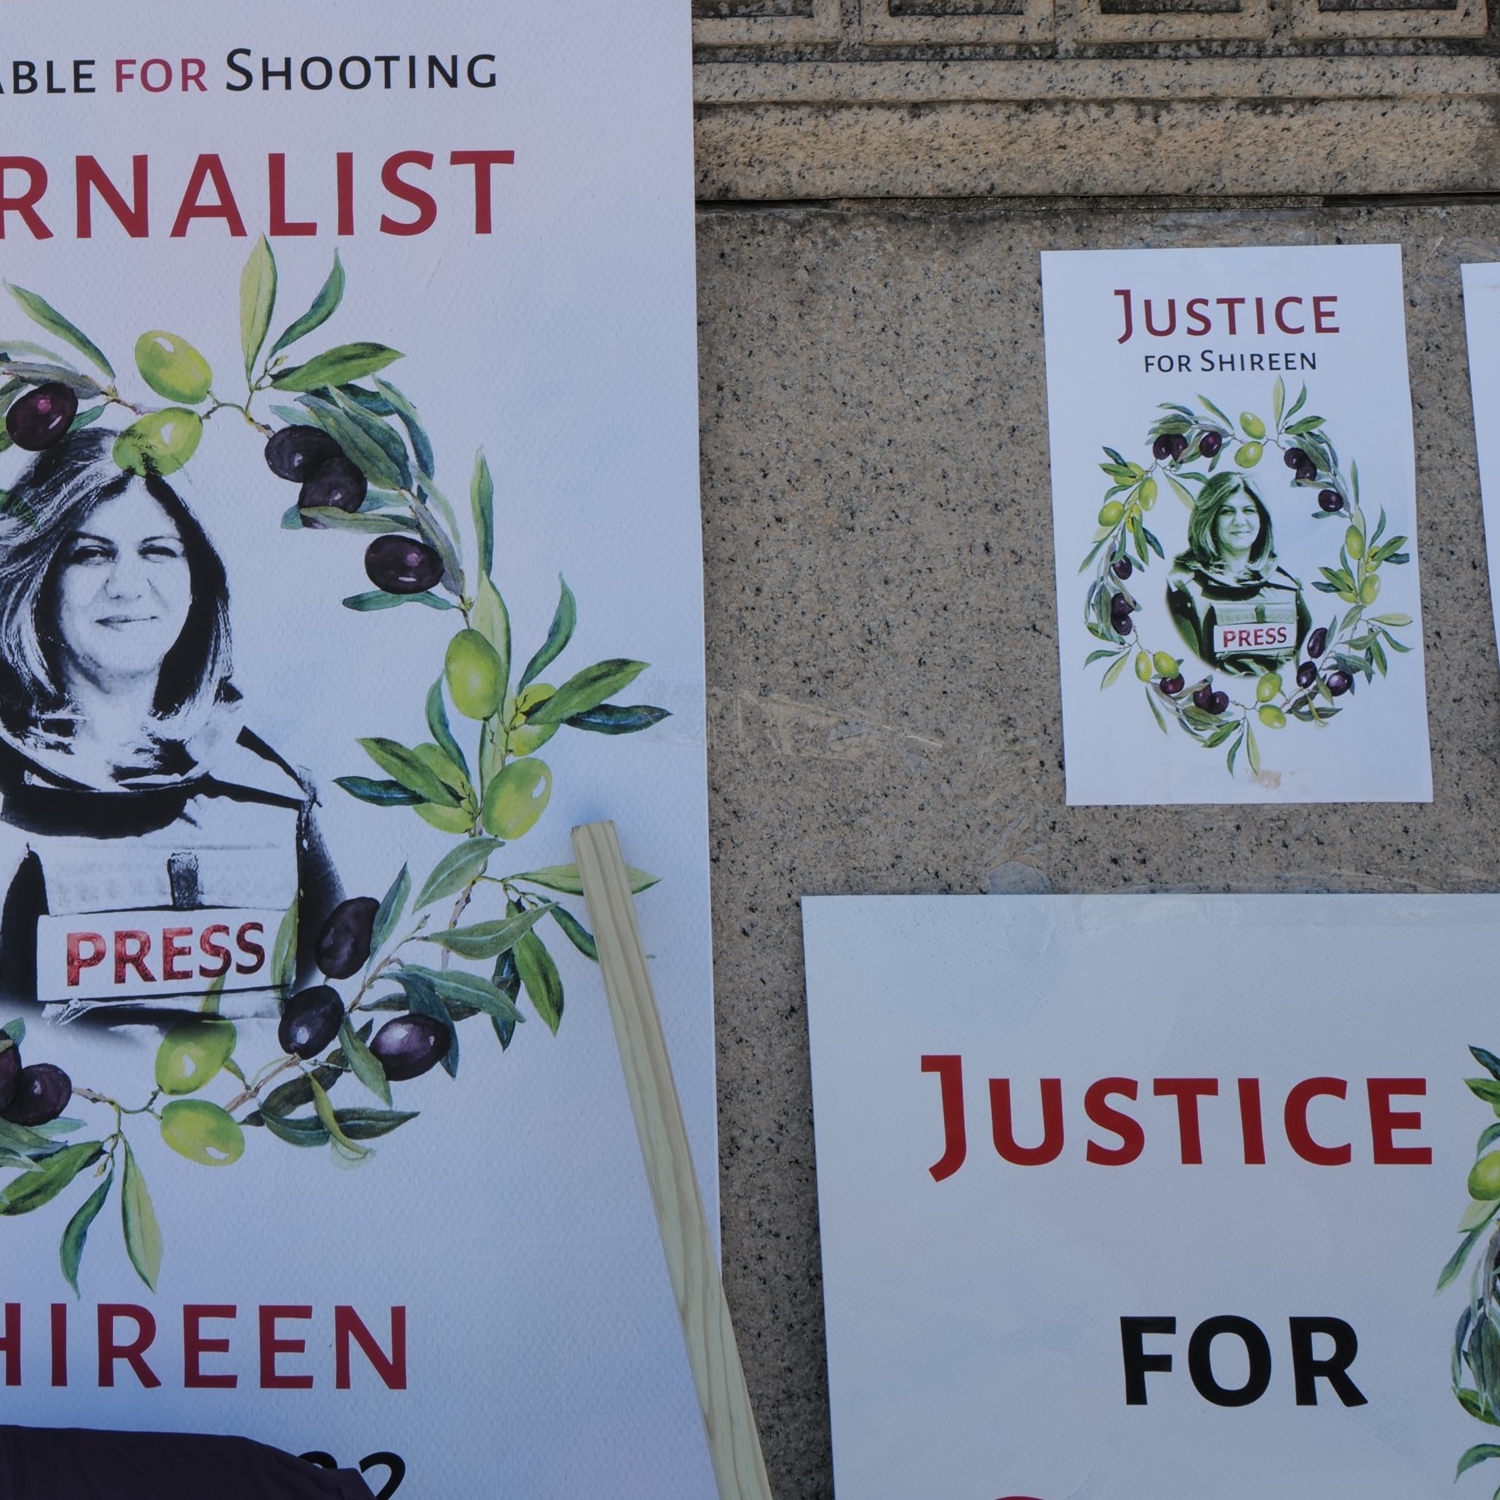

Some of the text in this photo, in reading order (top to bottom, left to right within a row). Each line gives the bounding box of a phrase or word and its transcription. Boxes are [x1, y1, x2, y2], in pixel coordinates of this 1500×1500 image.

[114, 58, 208, 93] FOR
[225, 47, 498, 92] SHOOTING
[1113, 289, 1340, 345] JUSTICE
[1144, 349, 1318, 373] FOR SHIREEN
[1222, 626, 1288, 649] PRESS
[66, 921, 266, 986] PRESS
[920, 1054, 1433, 1183] JUSTICE
[1119, 1314, 1369, 1408] FOR
